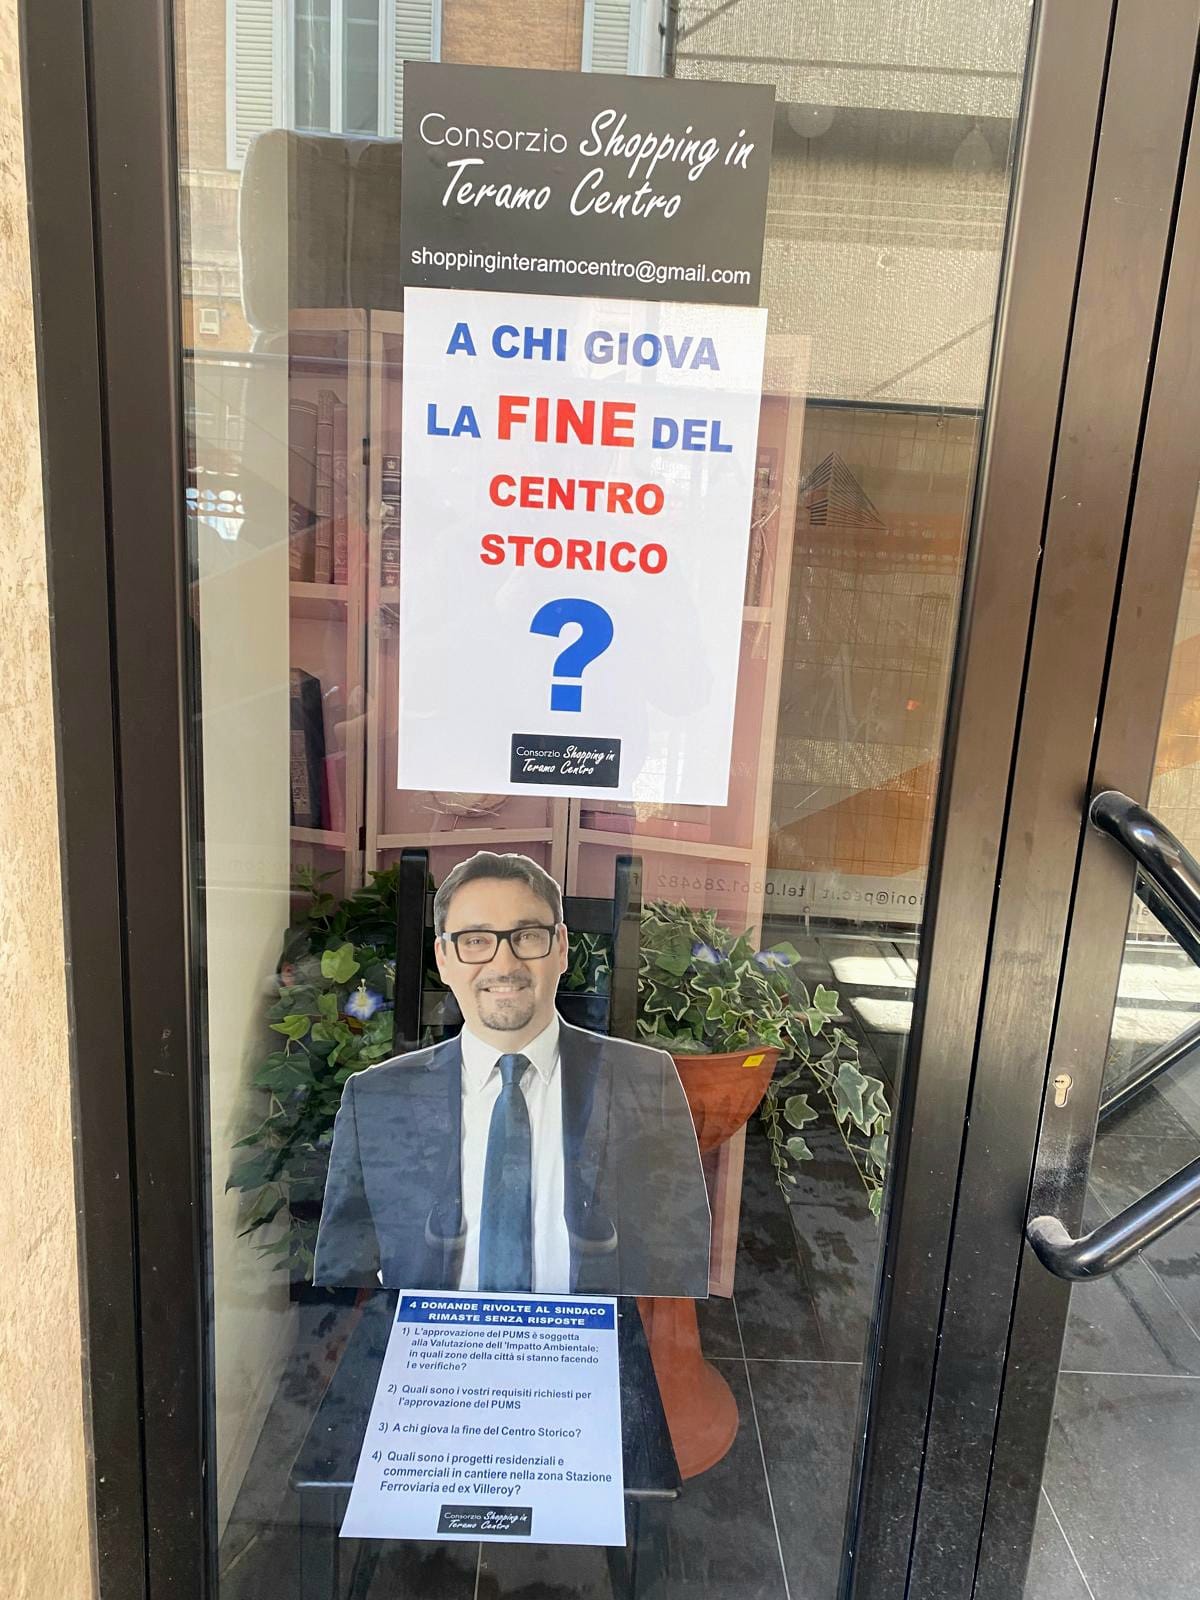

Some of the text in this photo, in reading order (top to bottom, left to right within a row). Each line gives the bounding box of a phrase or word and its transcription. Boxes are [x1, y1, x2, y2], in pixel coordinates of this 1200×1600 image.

[419, 109, 754, 181] Consorzio Shopping in
[442, 158, 681, 218] Teramo Centro
[411, 247, 751, 286] shoppinginteramocentro@gmail.com
[446, 322, 720, 371] A CHI GIOVA
[427, 395, 733, 453] LA FINE DEL
[489, 474, 665, 515] CENTRO
[480, 534, 668, 574] STORICO
[529, 597, 614, 712] ?
[516, 745, 616, 765] Consorzio Shopping in
[522, 758, 594, 775] Teramo Centro
[409, 1301, 606, 1316] 4 DOMANDE RIVOLTE AL SINDACO
[428, 1313, 585, 1326] RIMASTE SENZA RISPOSTE
[402, 1327, 410, 1337] 1)
[414, 1327, 485, 1340] L'approvazione
[487, 1329, 501, 1338] del
[503, 1330, 530, 1339] PUMS
[539, 1333, 580, 1342] soggetta
[411, 1339, 428, 1347] alla
[430, 1339, 484, 1349] Valutazione
[409, 1349, 599, 1364] in quali zone della città si stanno facendo
[419, 1361, 467, 1371] verifiche?
[387, 1384, 592, 1401] 2) Quali sono i vostri requisiti richiesti per
[398, 1396, 521, 1409] l'approvazione del PUMS
[378, 1422, 582, 1438] 3) A chi giova la fine del Centro Storico?
[371, 1450, 565, 1466] 4) Quali sono i progetti residenziali e
[383, 1467, 612, 1483] commerciali in cantiere nella zona Stazione
[380, 1480, 521, 1497] Ferroviaria ed ex Villeroy?
[444, 1512, 482, 1520] Consorzio
[483, 1510, 519, 1524] Shopping
